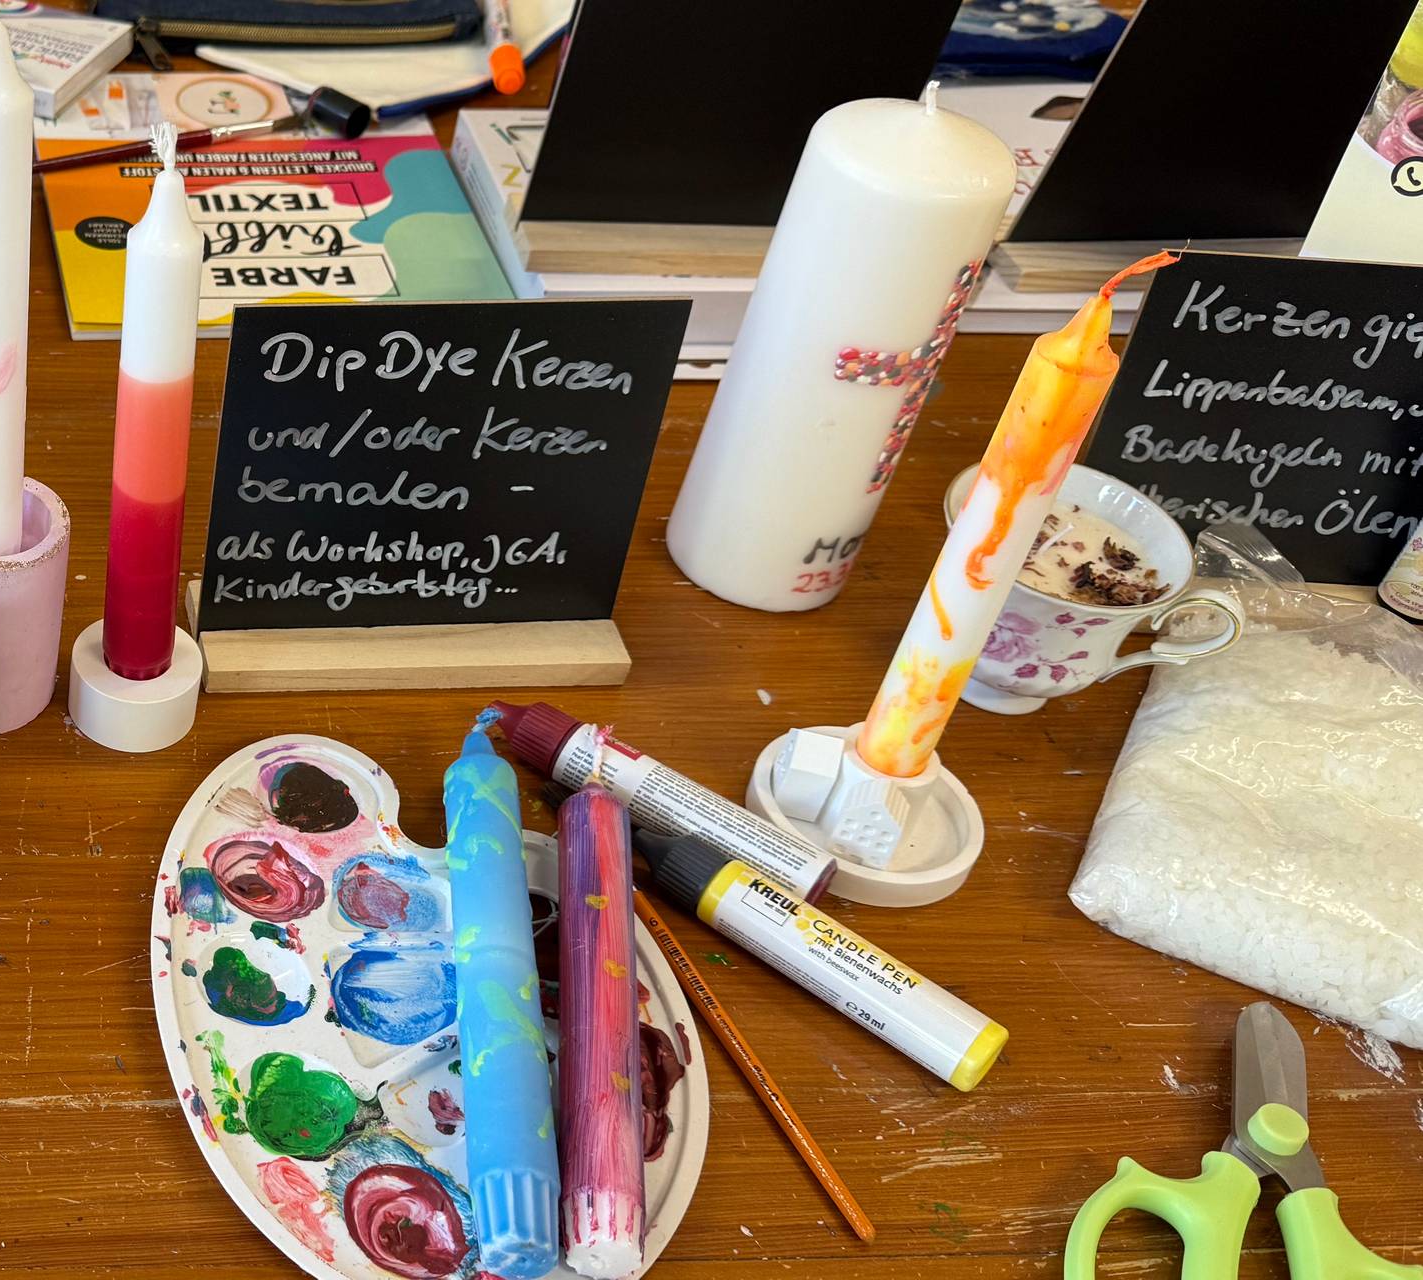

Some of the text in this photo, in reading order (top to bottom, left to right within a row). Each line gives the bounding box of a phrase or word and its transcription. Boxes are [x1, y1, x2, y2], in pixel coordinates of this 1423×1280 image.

[120, 166, 161, 177] STOFF
[193, 166, 235, 176] MALEN
[196, 151, 247, 162] FARBEN
[250, 164, 309, 174] LETTERN
[312, 162, 375, 173] DRUCKEN,
[333, 150, 358, 160] MIT
[188, 193, 329, 212] TEXTIL
[211, 266, 356, 286] FARBE
[1173, 280, 1351, 340] Kerzen
[260, 328, 633, 395] Dip Dye Kerzen
[1143, 359, 1405, 421] Lippenbalsam,
[248, 406, 608, 460] und/oder Kerzen
[1120, 424, 1423, 489] Badekugeln mit
[237, 466, 469, 511] bemalen
[1314, 488, 1418, 539] Ölen
[217, 530, 275, 562] als
[286, 529, 469, 570] Workshop,
[749, 878, 801, 917] KREUL
[807, 946, 860, 982] with beeswax
[813, 919, 879, 965] CANDLE
[881, 962, 918, 989] PEN
[814, 936, 903, 996] mit Bienenwachs
[858, 1008, 871, 1022] 29
[870, 1016, 886, 1031] ml
